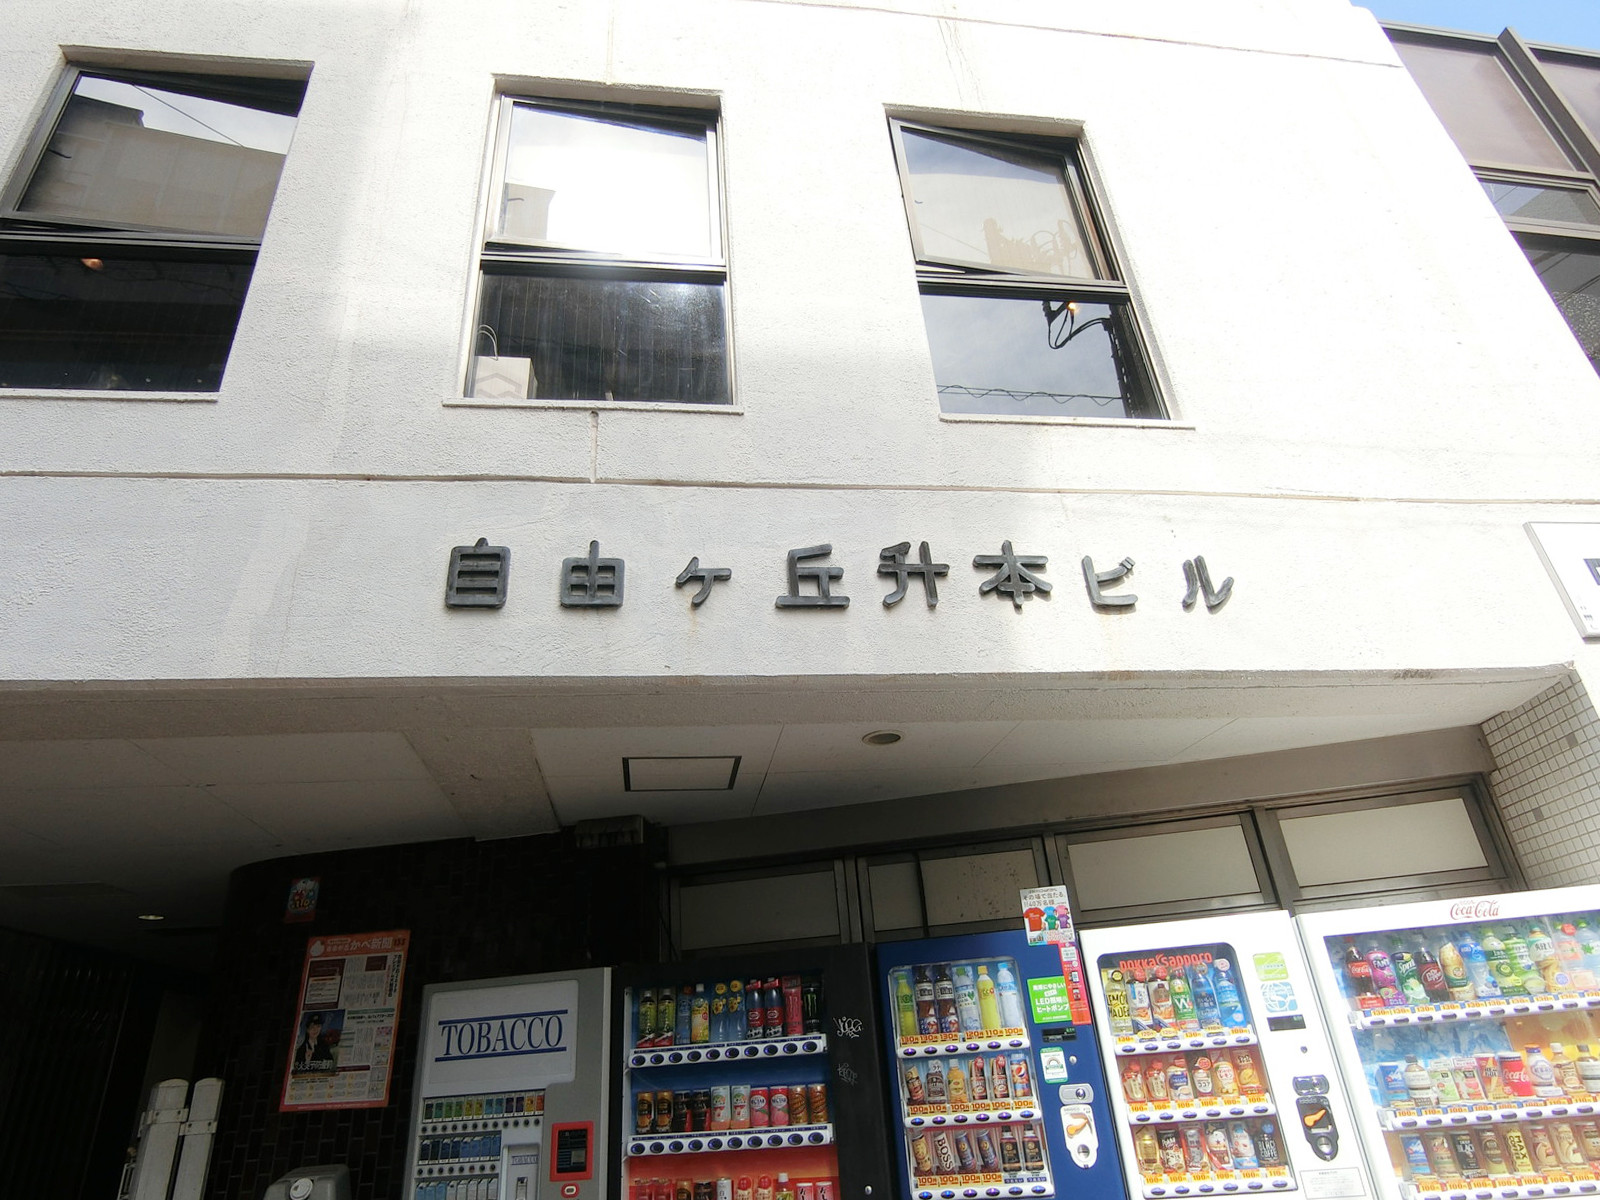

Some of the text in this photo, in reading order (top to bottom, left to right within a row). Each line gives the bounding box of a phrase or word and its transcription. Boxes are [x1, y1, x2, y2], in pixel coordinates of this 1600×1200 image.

[1036, 1003, 1069, 1013] ヒートポンプ
[441, 1015, 562, 1056] TOBACCO
[1004, 1027, 1023, 1035] 100円
[936, 1136, 953, 1170] BOSS
[1514, 1135, 1528, 1159] MAX
[982, 1173, 1002, 1181] 100円
